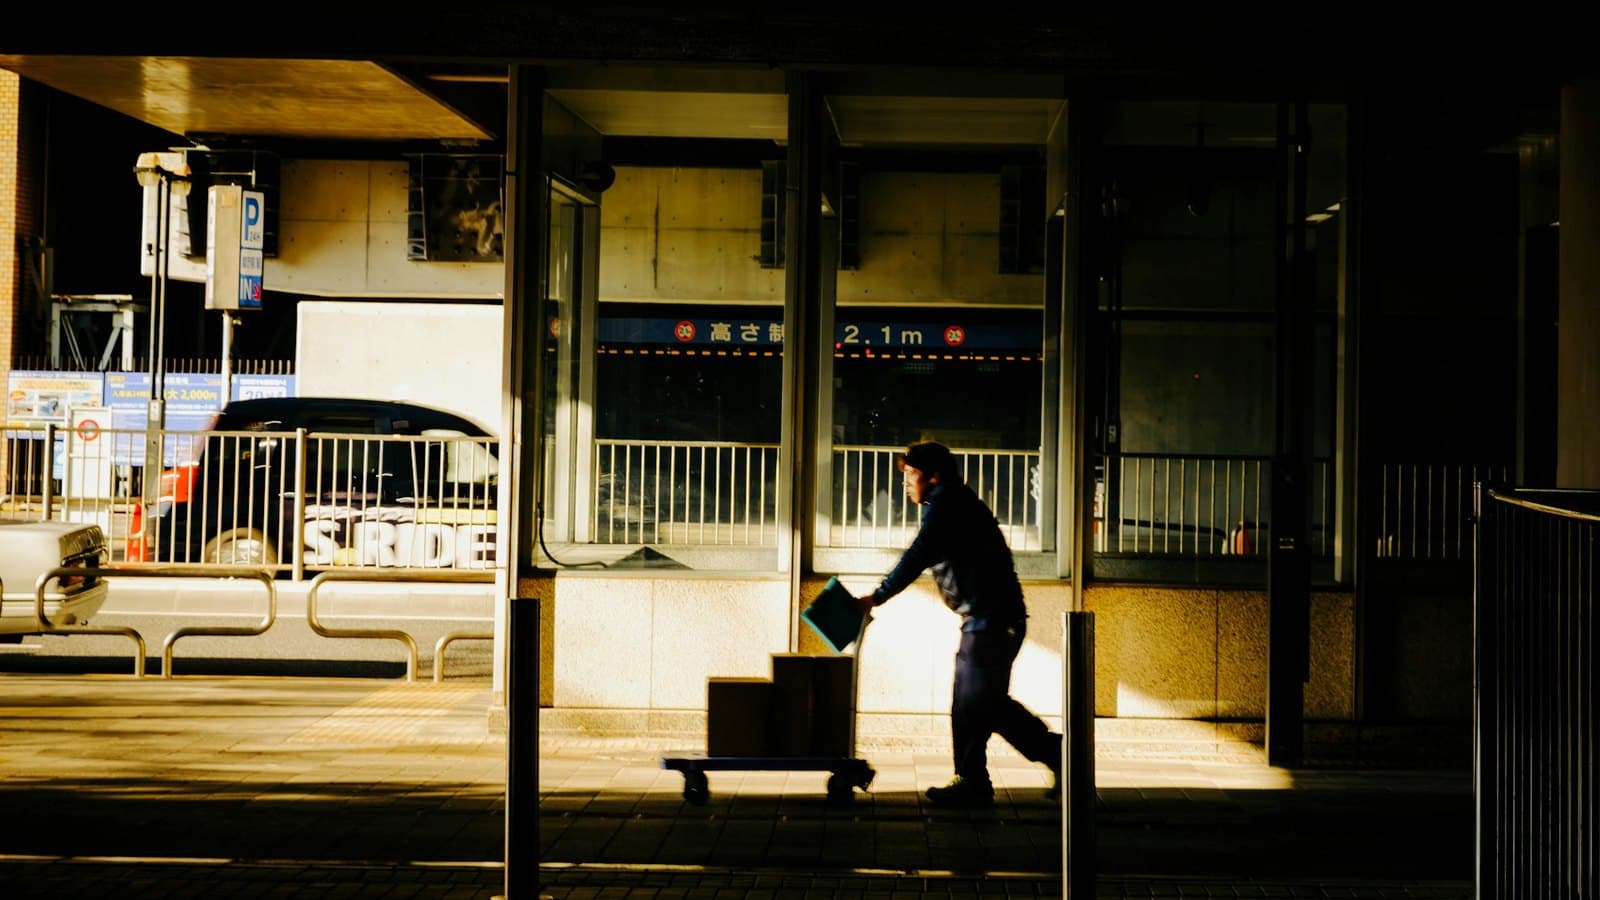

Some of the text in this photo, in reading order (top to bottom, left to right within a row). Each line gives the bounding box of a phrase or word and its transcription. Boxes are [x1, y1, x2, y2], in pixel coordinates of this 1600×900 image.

[245, 197, 259, 241] P
[240, 278, 252, 300] IN
[843, 323, 923, 345] 2.1m
